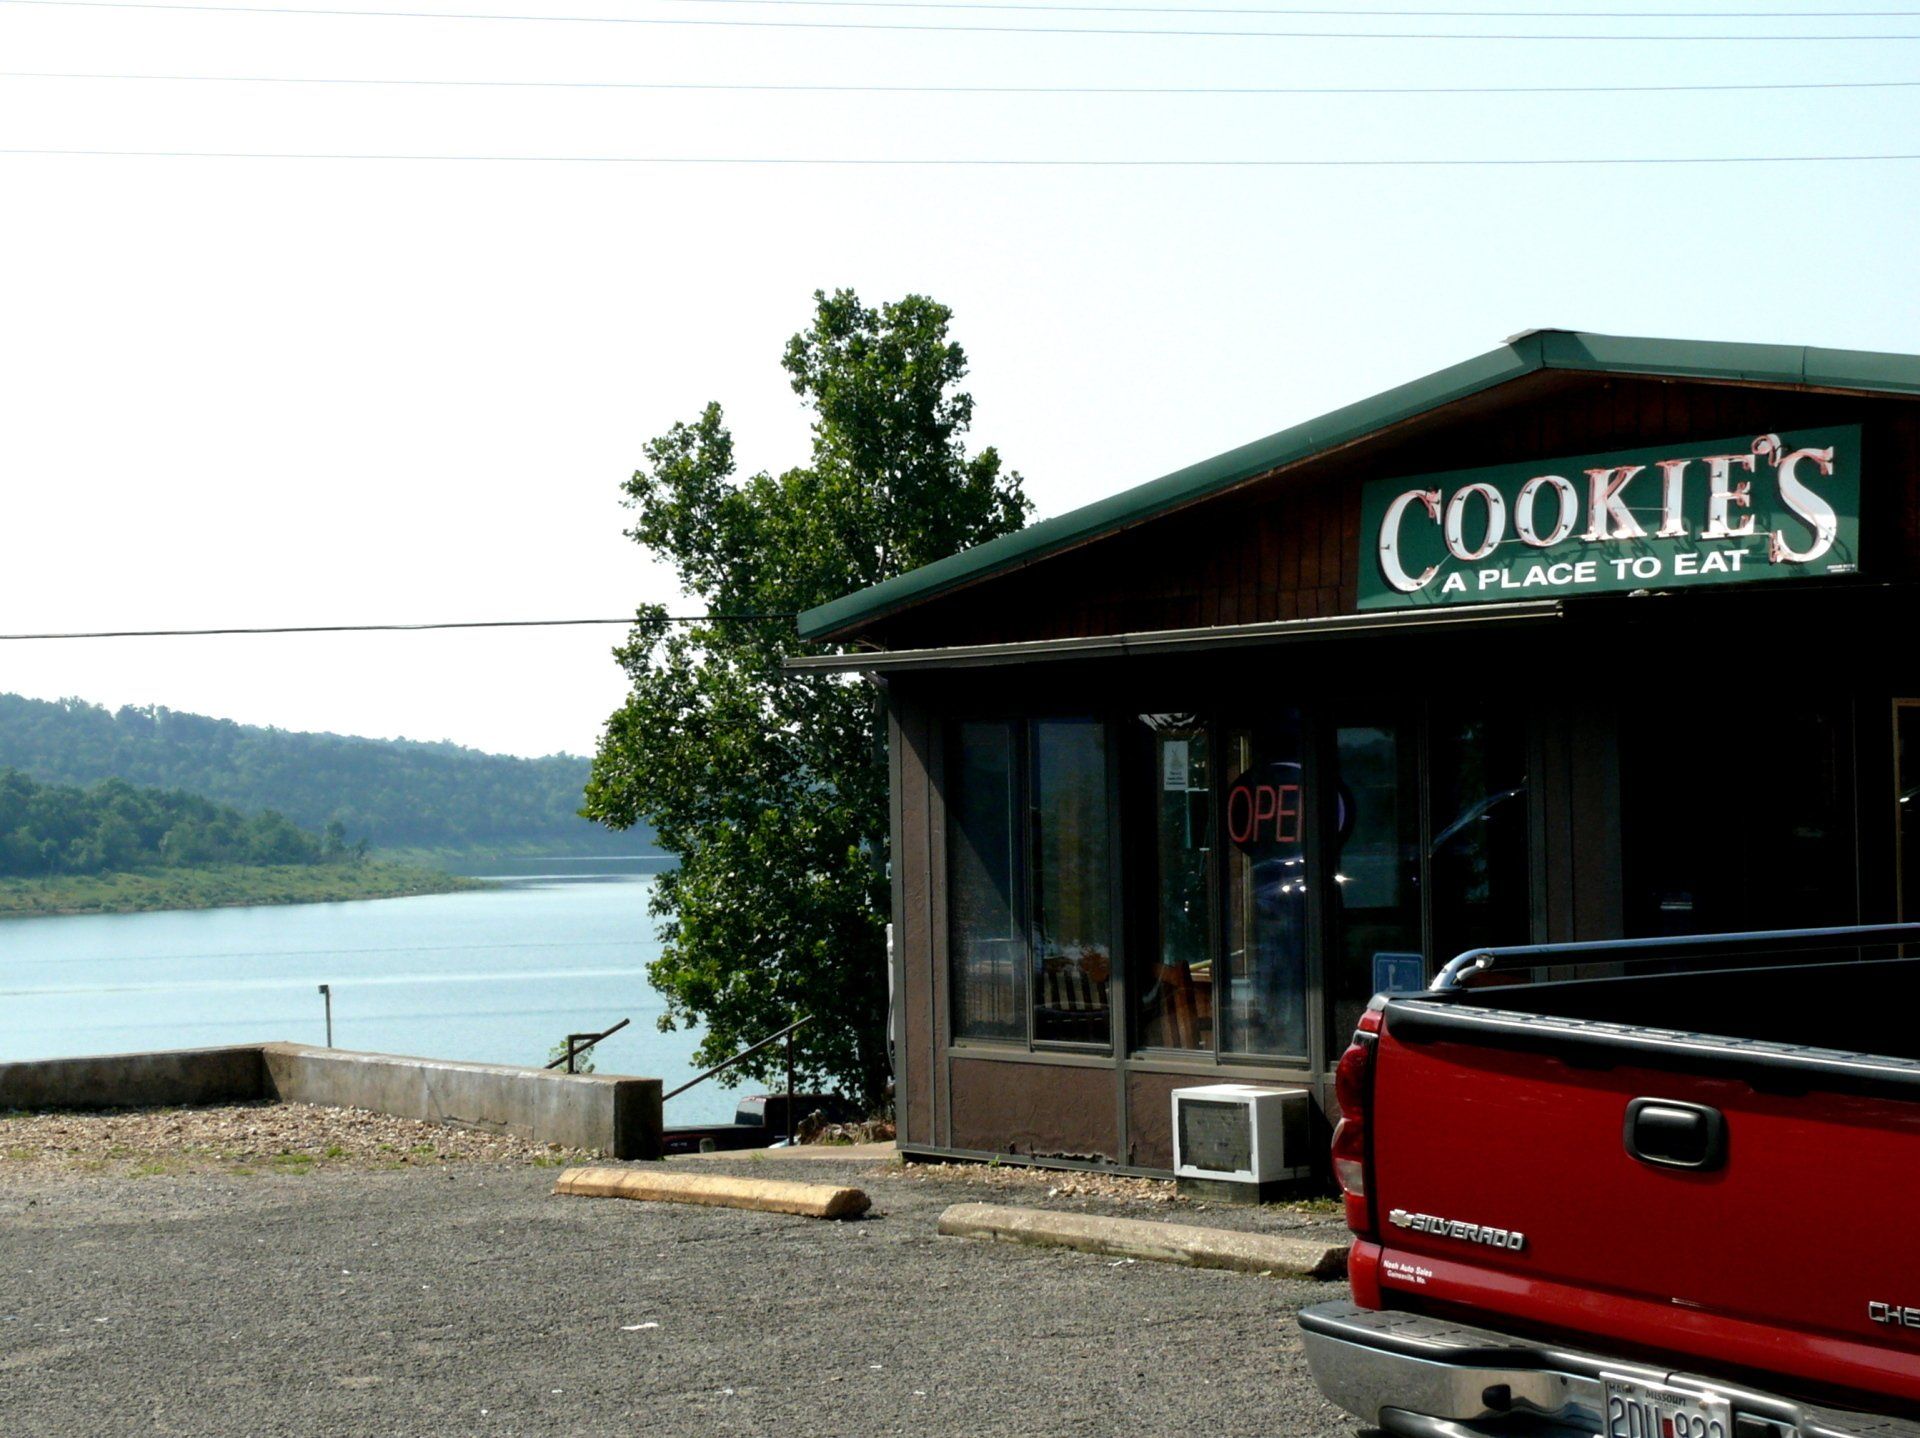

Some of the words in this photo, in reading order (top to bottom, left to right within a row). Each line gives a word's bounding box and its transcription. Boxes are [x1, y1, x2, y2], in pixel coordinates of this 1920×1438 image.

[1378, 433, 1838, 592] COOKIE'S
[1442, 572, 1467, 593] A
[1478, 561, 1597, 591] PLACE
[1610, 557, 1662, 580] TO
[1674, 549, 1750, 576] EAT
[1228, 784, 1304, 842] OPE
[1411, 1213, 1524, 1250] SILVERADO
[1400, 1264, 1415, 1273] Auto
[1415, 1266, 1433, 1277] Sales
